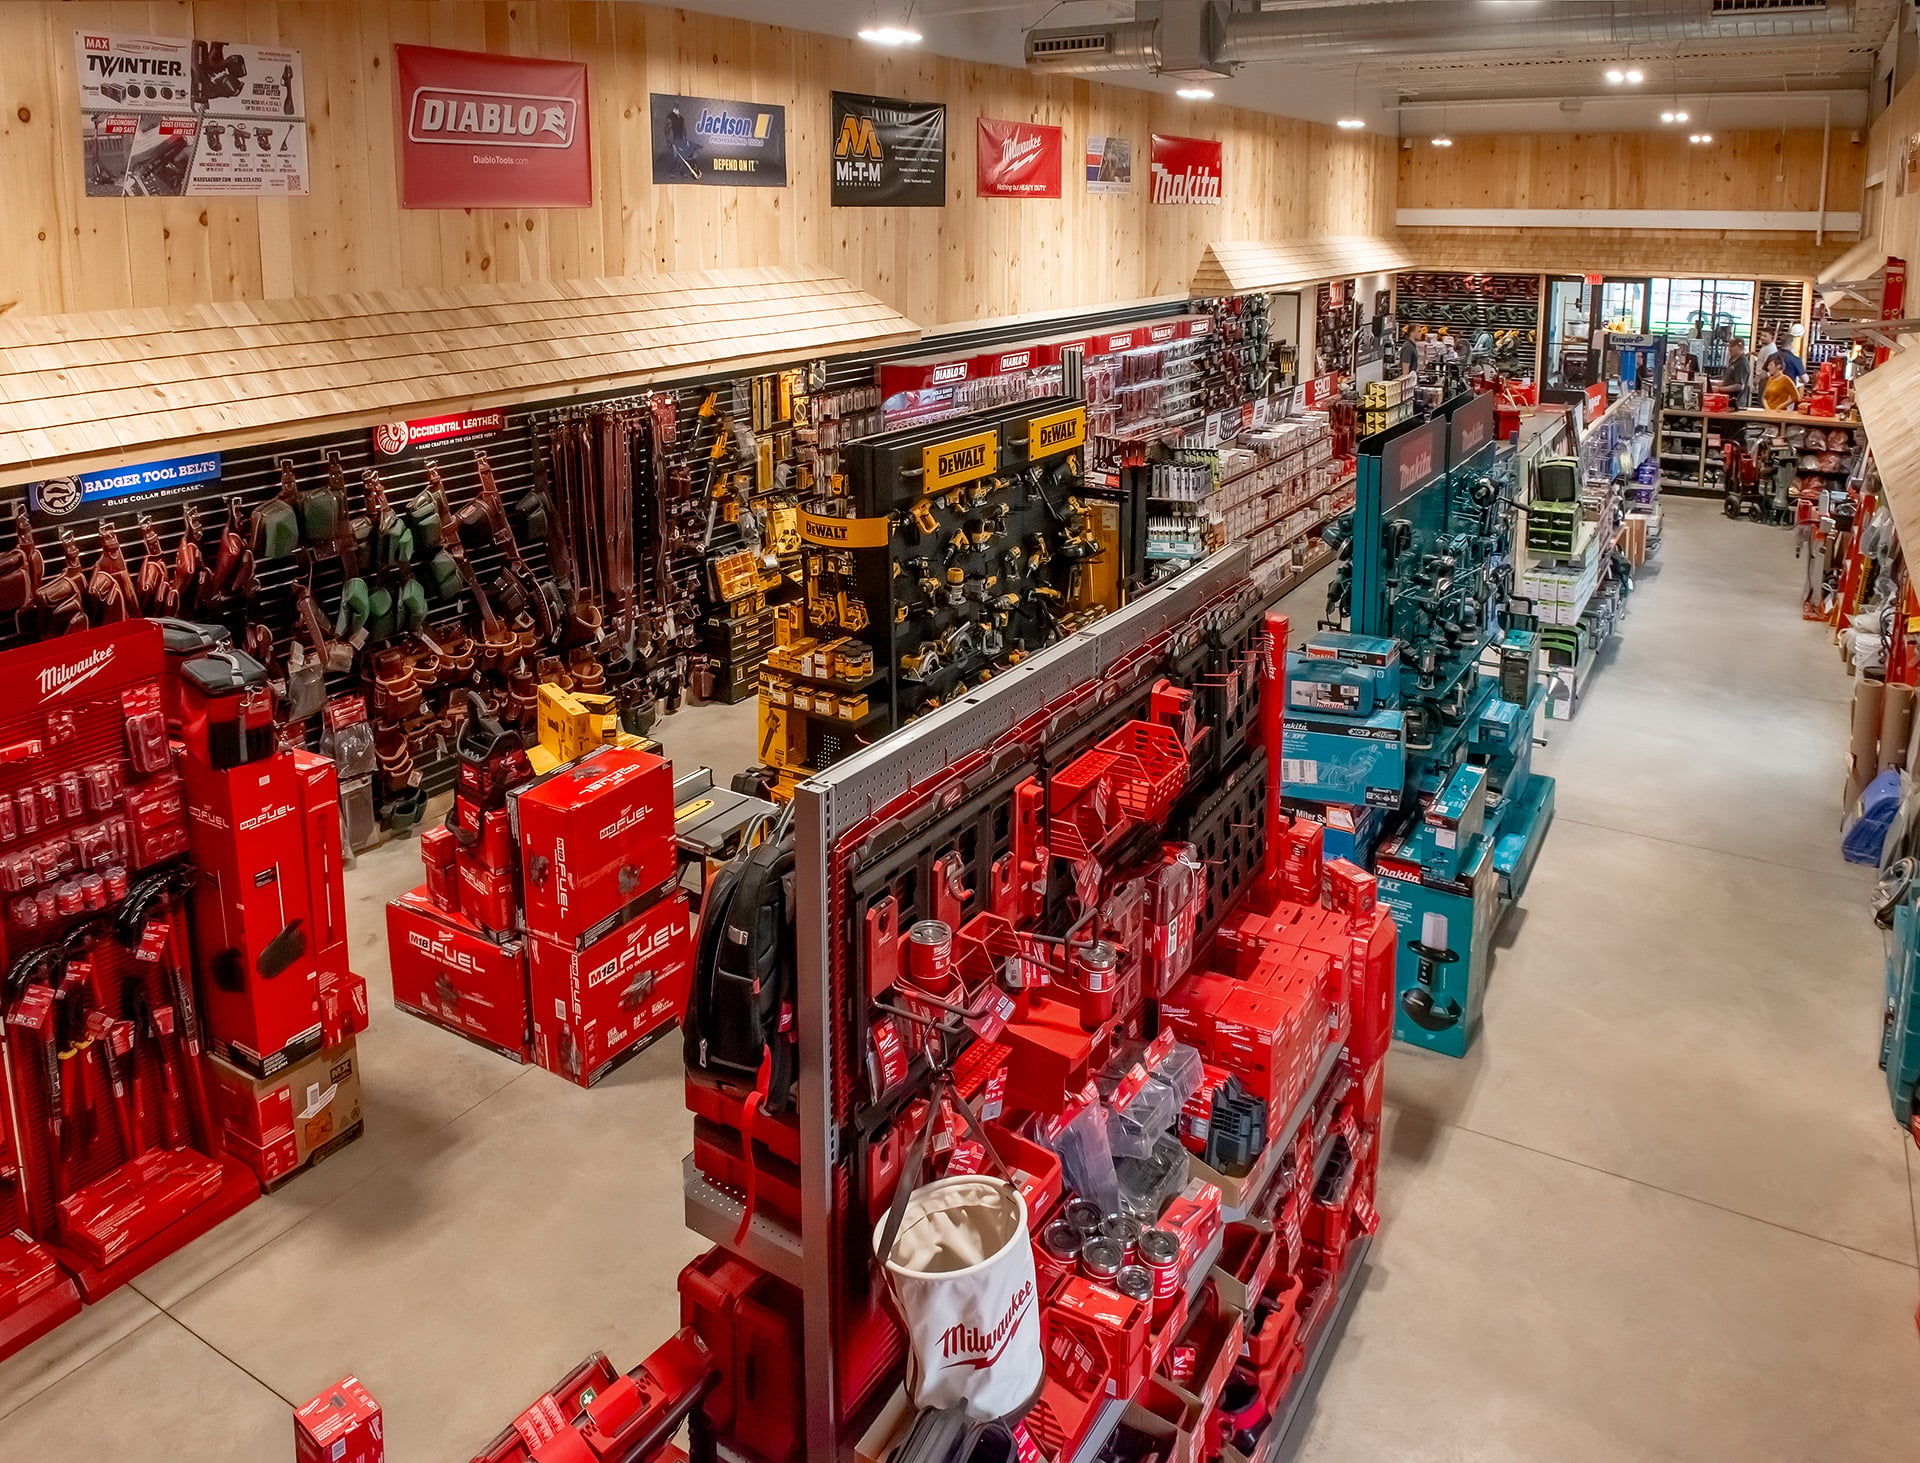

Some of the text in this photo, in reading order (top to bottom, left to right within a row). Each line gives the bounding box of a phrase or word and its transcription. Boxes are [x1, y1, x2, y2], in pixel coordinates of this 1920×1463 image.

[86, 38, 109, 50] MAX
[86, 54, 183, 78] TWINTIER
[161, 121, 196, 129] COST-EFFICIENT
[421, 98, 538, 136] DIABLO
[696, 108, 753, 138] Jackson
[1001, 132, 1042, 162] Milwaukee
[473, 155, 529, 165] DiabloTools.com
[713, 158, 738, 171] DEPEND
[739, 159, 748, 172] ON
[836, 161, 881, 182] Mi-T-M
[996, 184, 1012, 193] Nothing
[1034, 184, 1047, 192] DUTY
[935, 367, 959, 380] DIABLO
[1001, 357, 1024, 369] DIABLO
[1314, 375, 1331, 397] SENCO
[409, 414, 500, 440] OCCIDENTAL LEATHER
[431, 439, 449, 448] CRAFTED
[83, 460, 216, 494] BADGER TOOL BELTS
[107, 485, 198, 507] BLUE COLLAR BRIEFCASE
[35, 648, 113, 694] Milwaukee
[257, 804, 295, 823] FUEL
[600, 804, 653, 840] M18 FUEL
[1295, 809, 1327, 824] Miter Sa
[559, 863, 569, 919] FUEL
[1377, 879, 1400, 892] LXT
[409, 931, 486, 974] M18 FUEL
[589, 957, 618, 989] M18
[620, 922, 684, 969] FUEL
[626, 964, 634, 972] TO
[573, 977, 581, 1026] FUEL
[332, 1061, 350, 1080] MX
[936, 1279, 1033, 1358] Milwaukee
